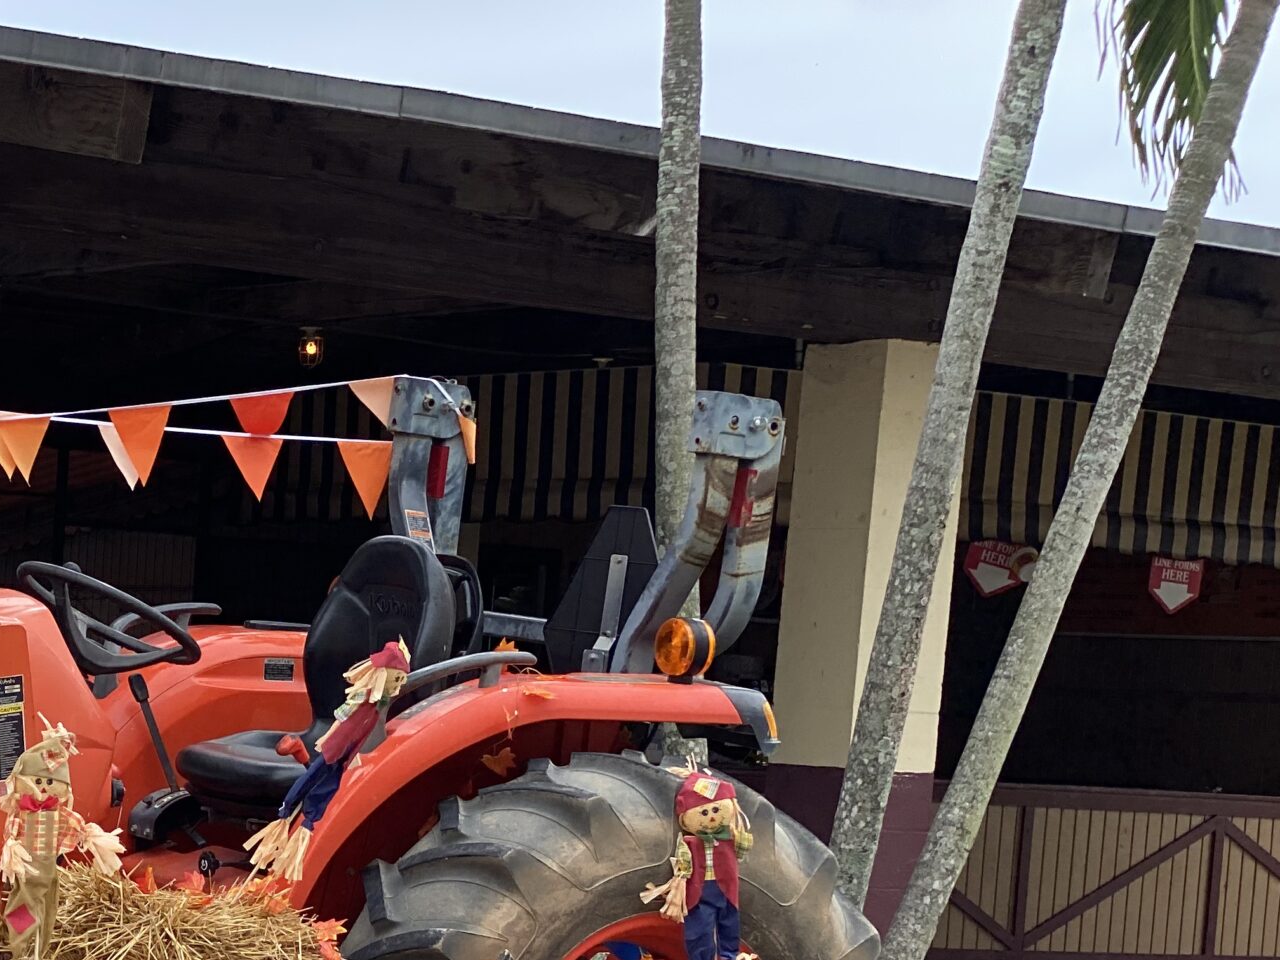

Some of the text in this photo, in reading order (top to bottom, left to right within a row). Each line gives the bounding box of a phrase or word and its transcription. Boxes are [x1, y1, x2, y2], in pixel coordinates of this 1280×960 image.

[1154, 557, 1201, 573] LINE FORMS
[1162, 568, 1190, 583] HERE
